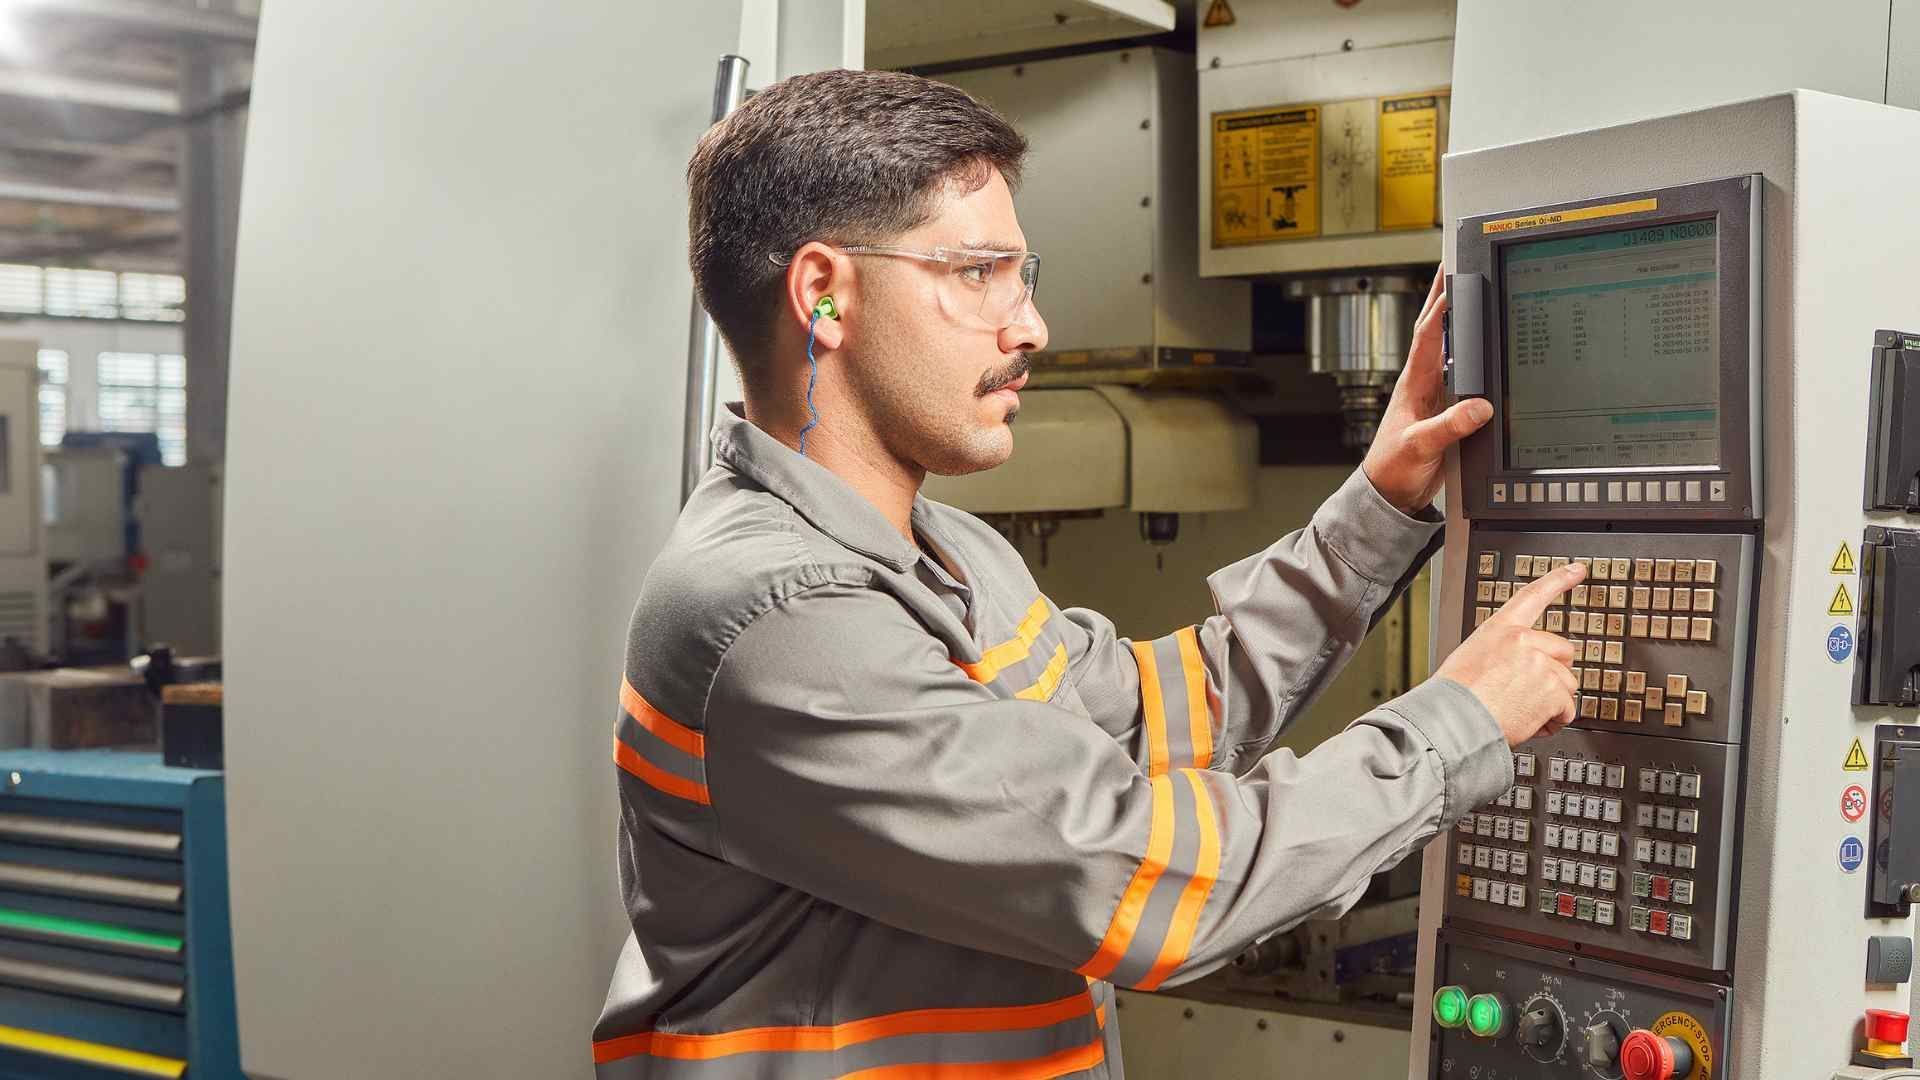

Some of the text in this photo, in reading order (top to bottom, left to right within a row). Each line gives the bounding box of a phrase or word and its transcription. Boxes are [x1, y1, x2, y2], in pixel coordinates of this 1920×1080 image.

[1489, 222, 1512, 232] FANUC
[1515, 219, 1536, 228] Series
[1600, 563, 1606, 573] 8
[1619, 563, 1626, 574] 9
[1597, 591, 1605, 602] 5
[1616, 592, 1625, 602] 6
[1552, 616, 1560, 627] M
[1595, 618, 1603, 629] 2
[1614, 620, 1621, 630] 3
[1653, 1015, 1710, 1062] ERGENCY-STOP
